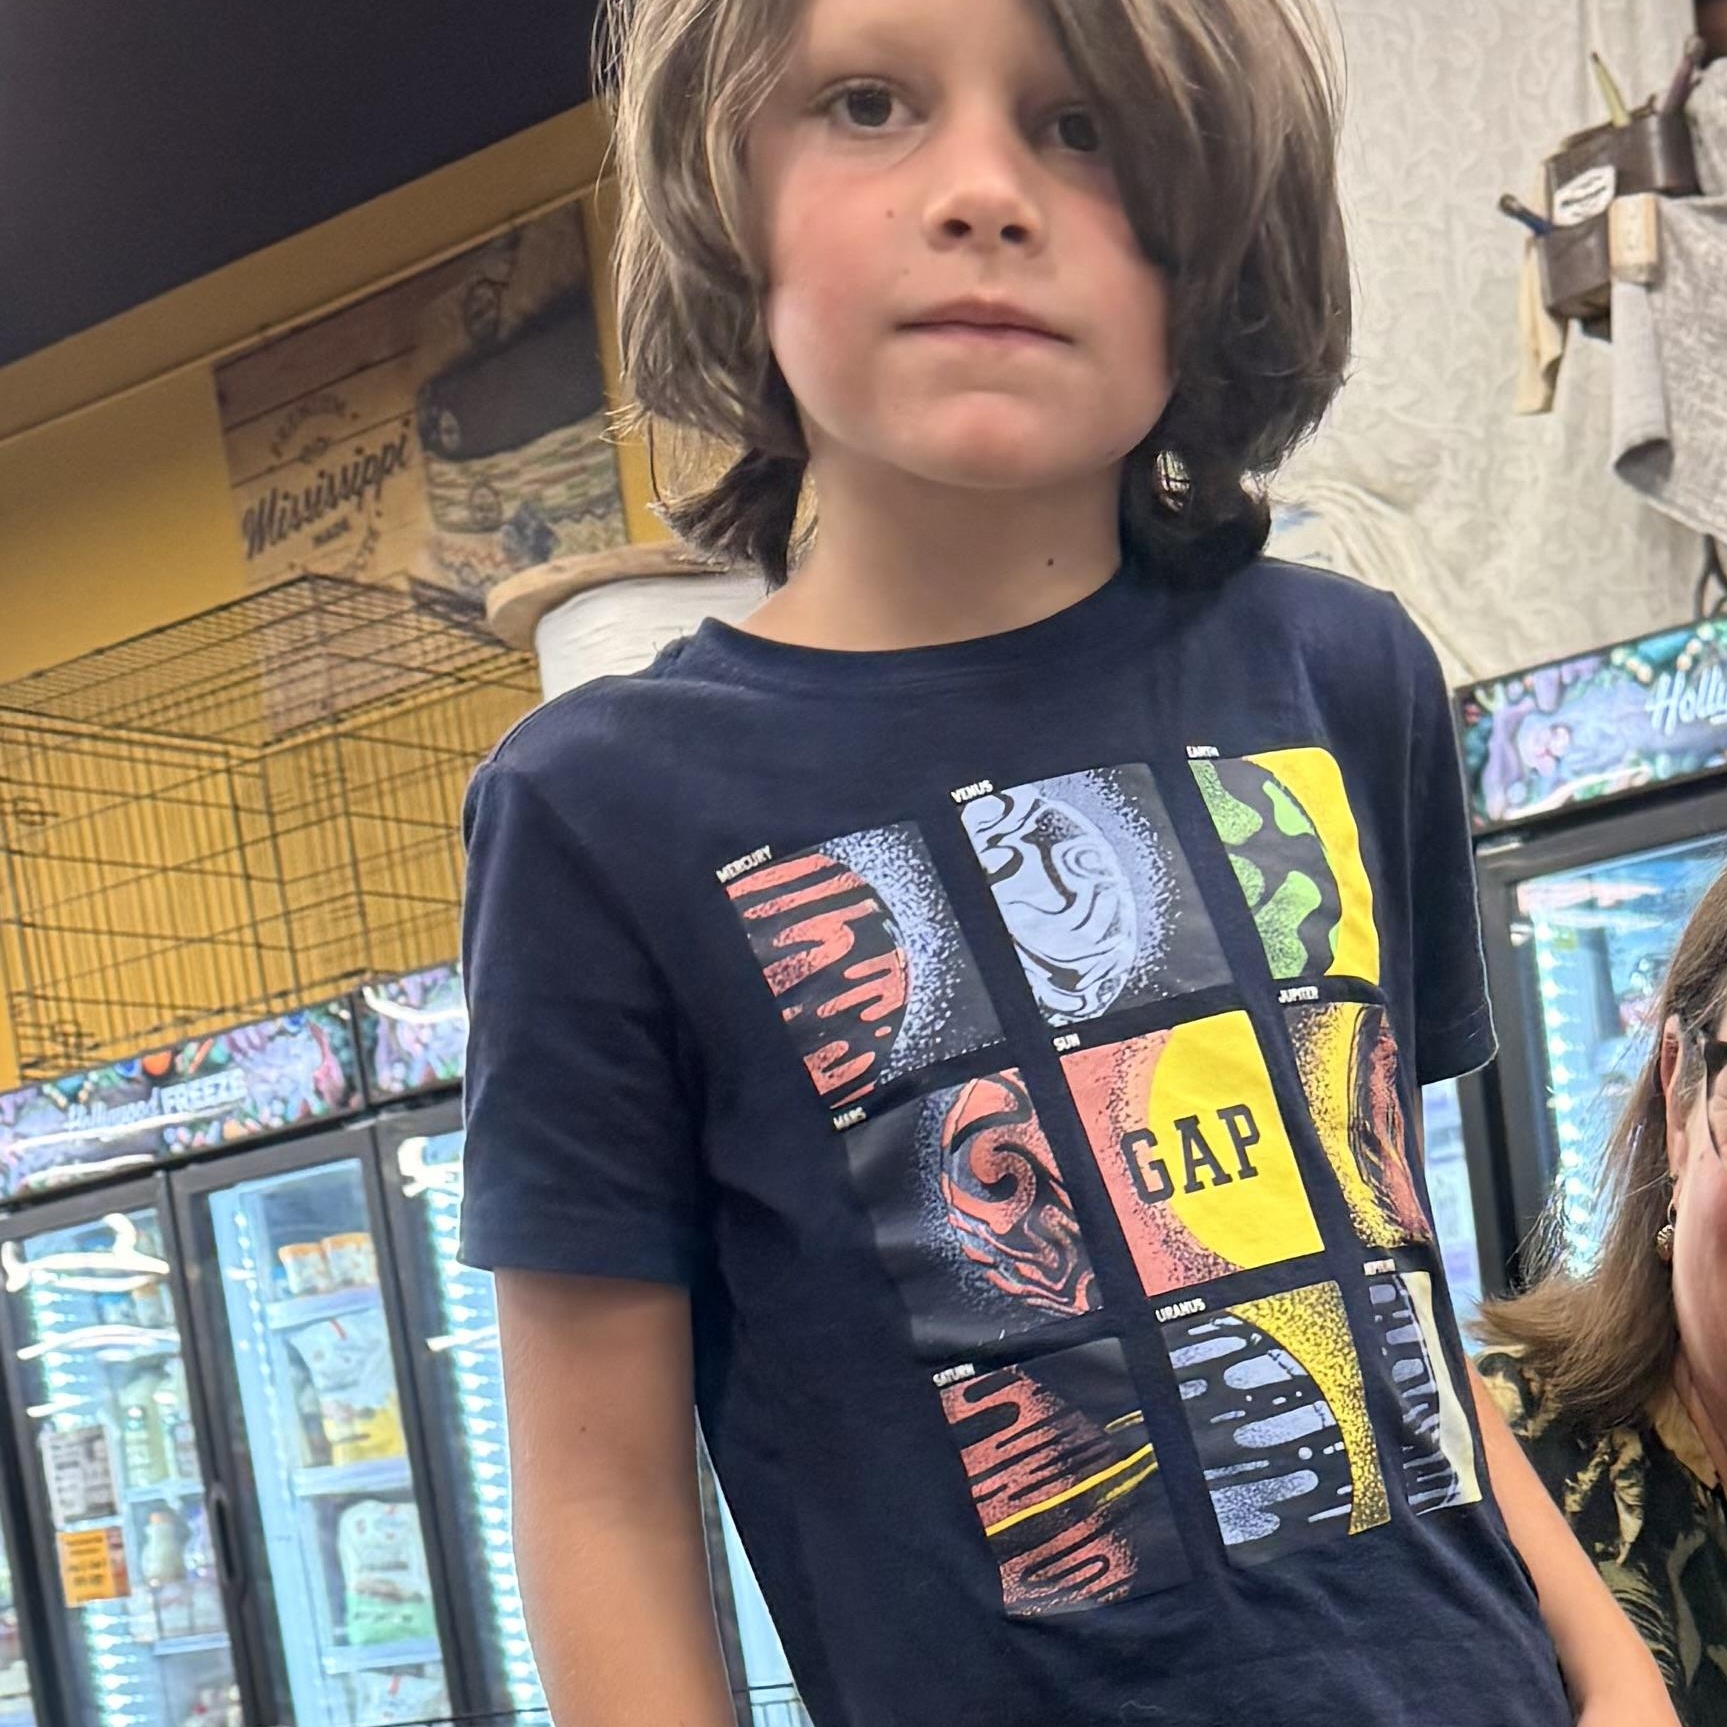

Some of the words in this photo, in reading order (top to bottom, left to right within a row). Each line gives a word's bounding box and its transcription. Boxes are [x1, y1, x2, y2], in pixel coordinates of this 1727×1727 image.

[950, 779, 994, 803] VENUS
[715, 844, 772, 884] MERCURY
[1053, 1032, 1081, 1052] SUN
[833, 1106, 867, 1131] MARS
[1119, 1104, 1260, 1204] GAP
[1155, 1297, 1206, 1323] URANUS
[932, 1362, 976, 1387] SATURN
